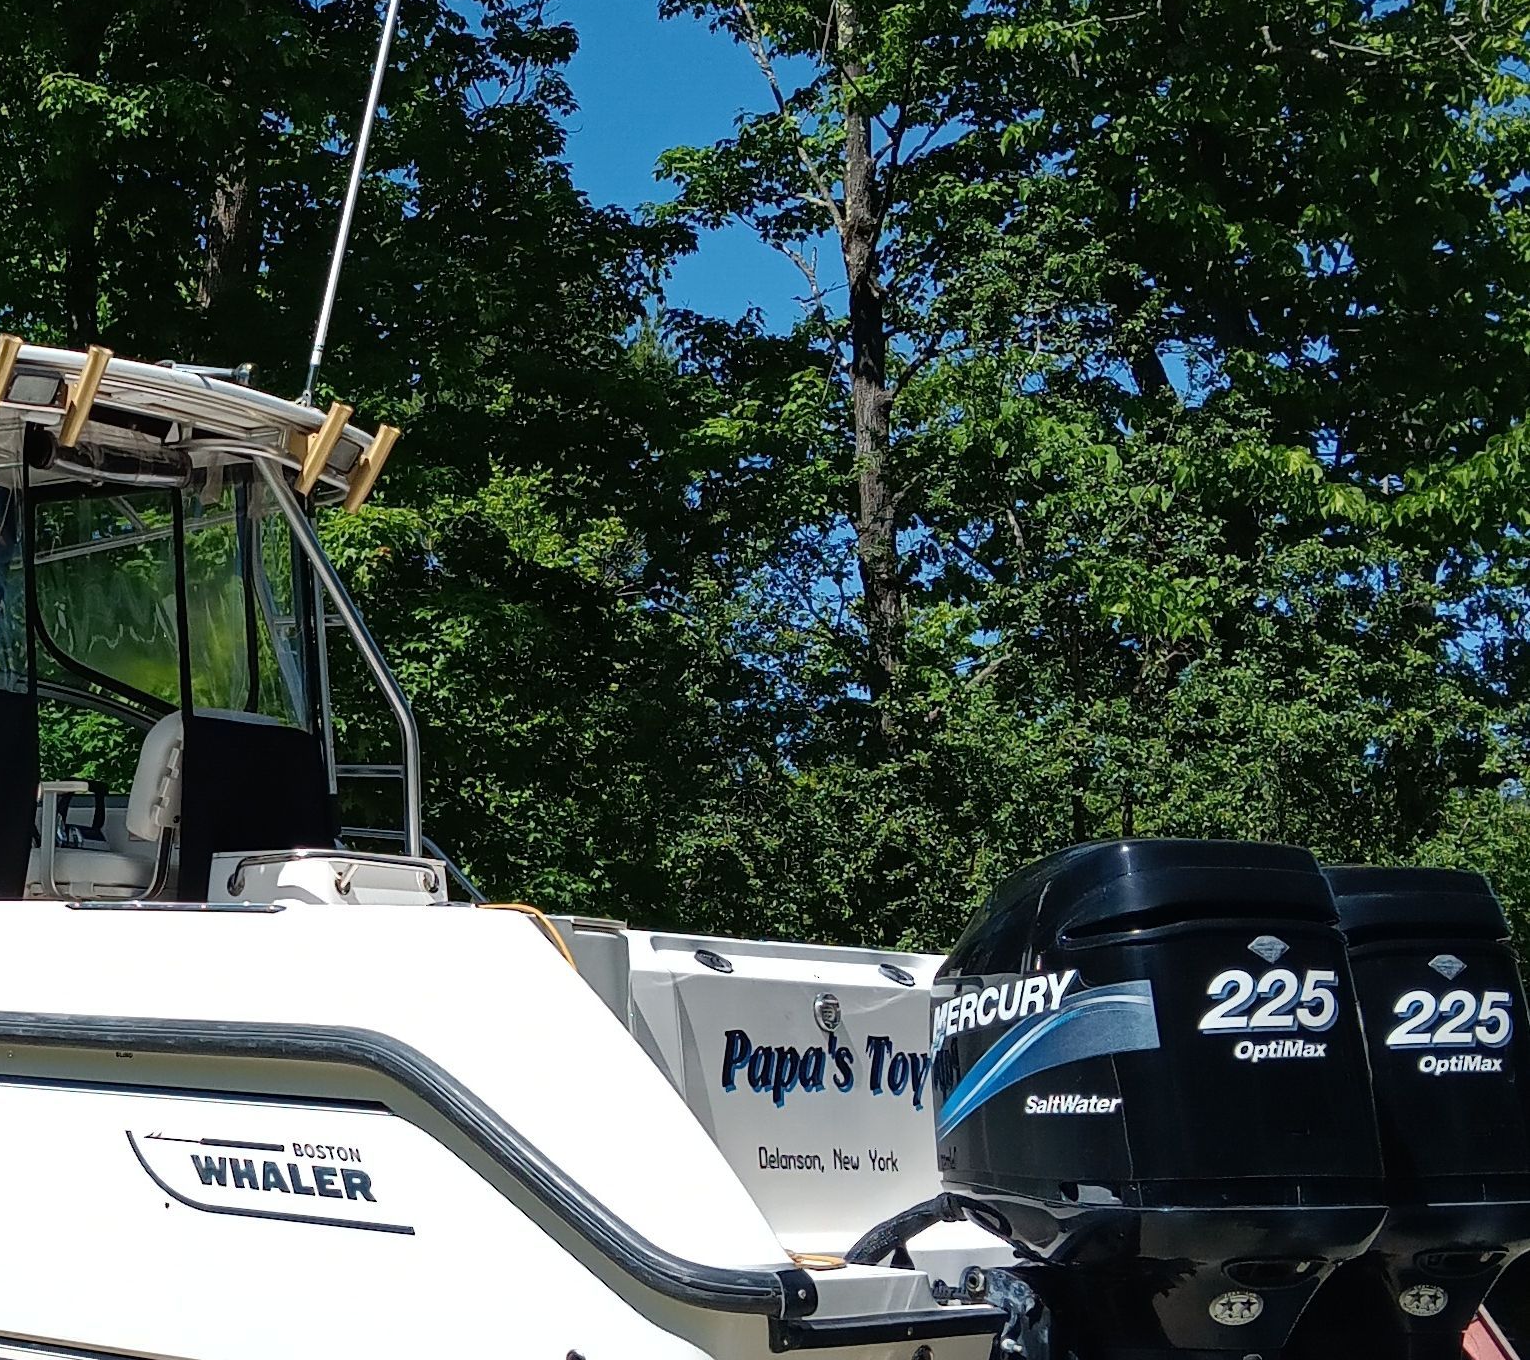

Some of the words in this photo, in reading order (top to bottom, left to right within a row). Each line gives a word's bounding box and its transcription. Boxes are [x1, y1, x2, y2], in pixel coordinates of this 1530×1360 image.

[933, 969, 1078, 1039] MERCURY
[1198, 968, 1339, 1036] 225
[1385, 989, 1513, 1049] 225
[722, 1029, 855, 1109] Papa's
[865, 1035, 933, 1111] Toy
[1233, 1040, 1327, 1062] OptiMax
[1419, 1055, 1503, 1075] OptiMax
[1025, 1094, 1123, 1115] SaltWater
[292, 1142, 362, 1163] BOSTON
[758, 1146, 825, 1173] Delanson,
[833, 1148, 860, 1171] New
[868, 1148, 900, 1172] York
[190, 1154, 378, 1203] WHALER
